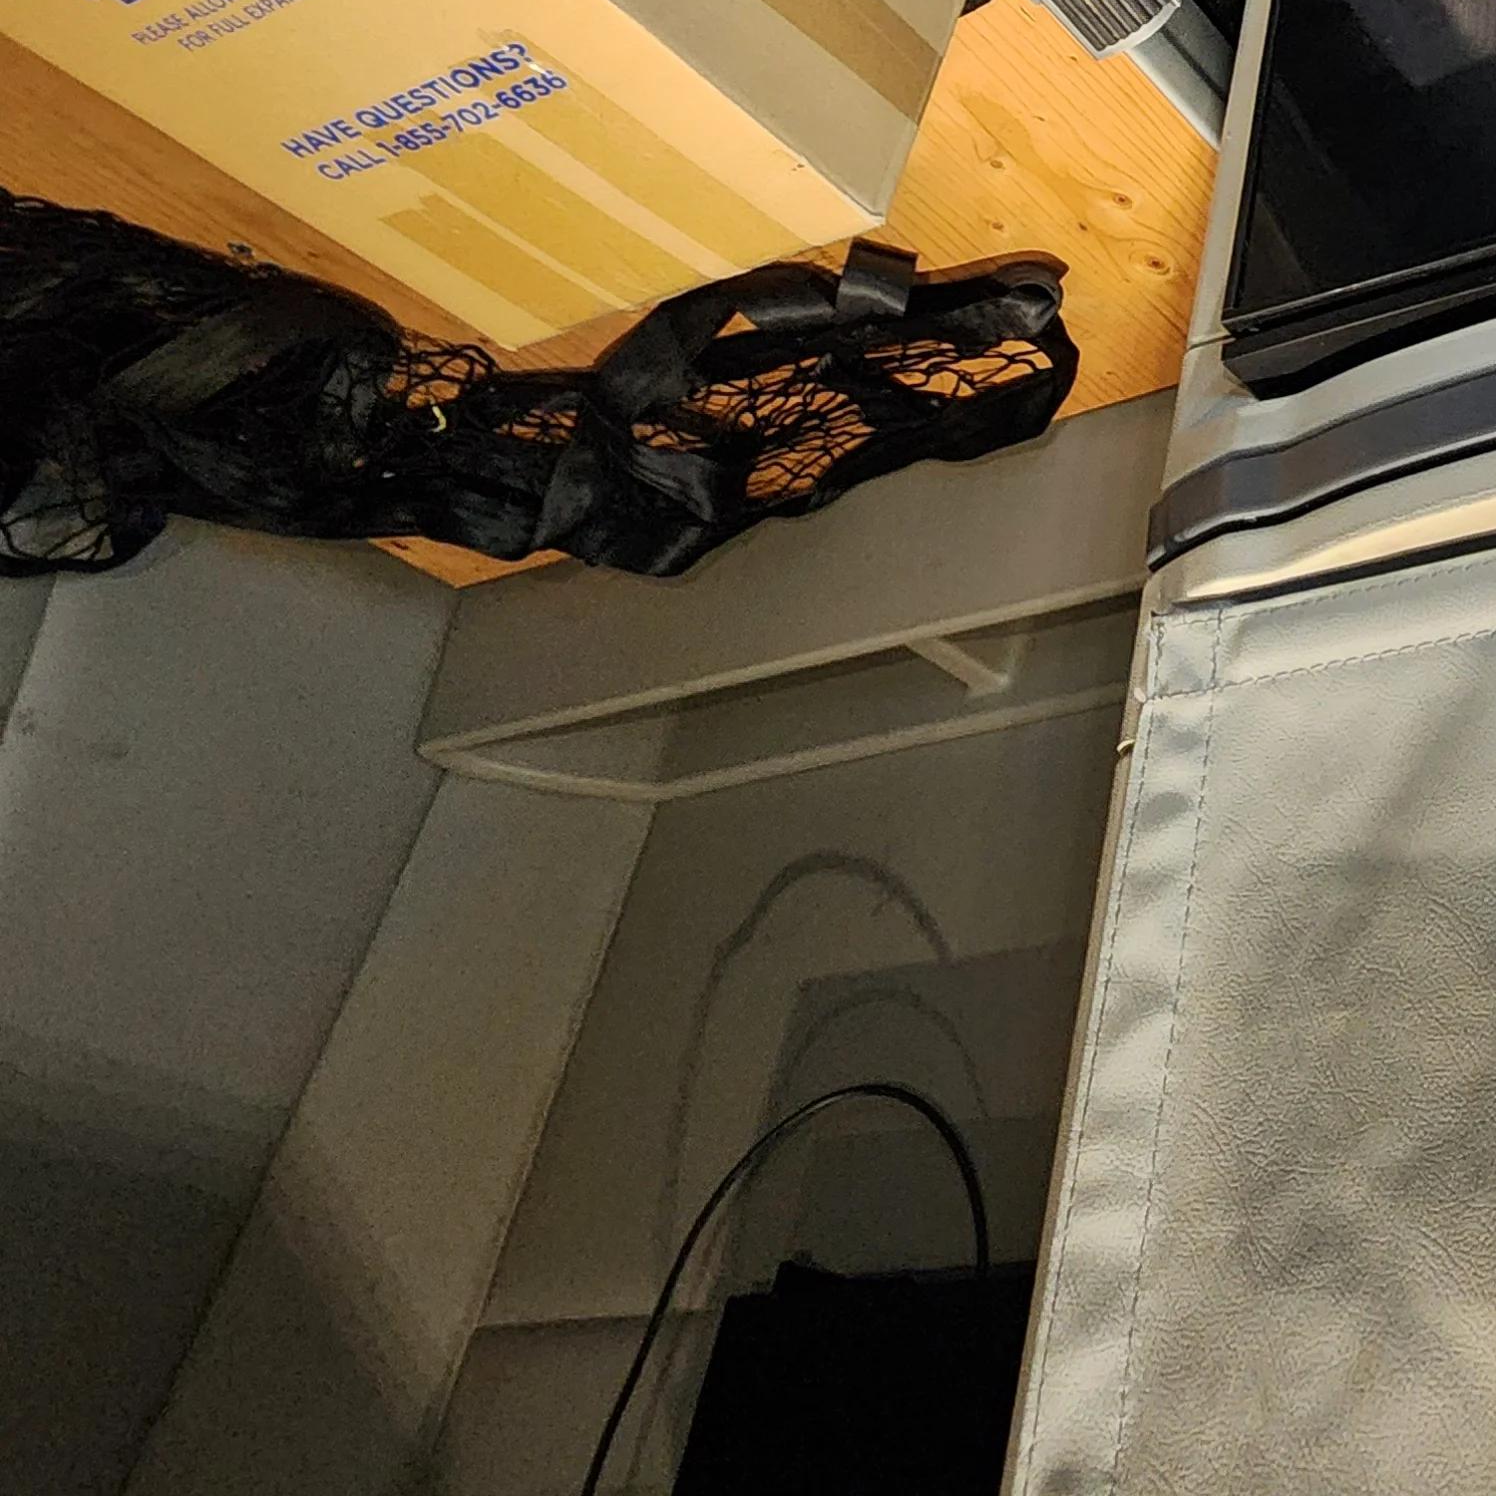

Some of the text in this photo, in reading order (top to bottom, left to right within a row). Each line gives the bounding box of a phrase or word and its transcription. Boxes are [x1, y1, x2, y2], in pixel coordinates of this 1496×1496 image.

[131, 13, 189, 45] PLEASE
[177, 30, 217, 52] FOR
[208, 14, 251, 38] FULL
[281, 43, 532, 158] HAVE QUESTIONS?
[317, 70, 567, 180] CALL 1-855-702-6636
